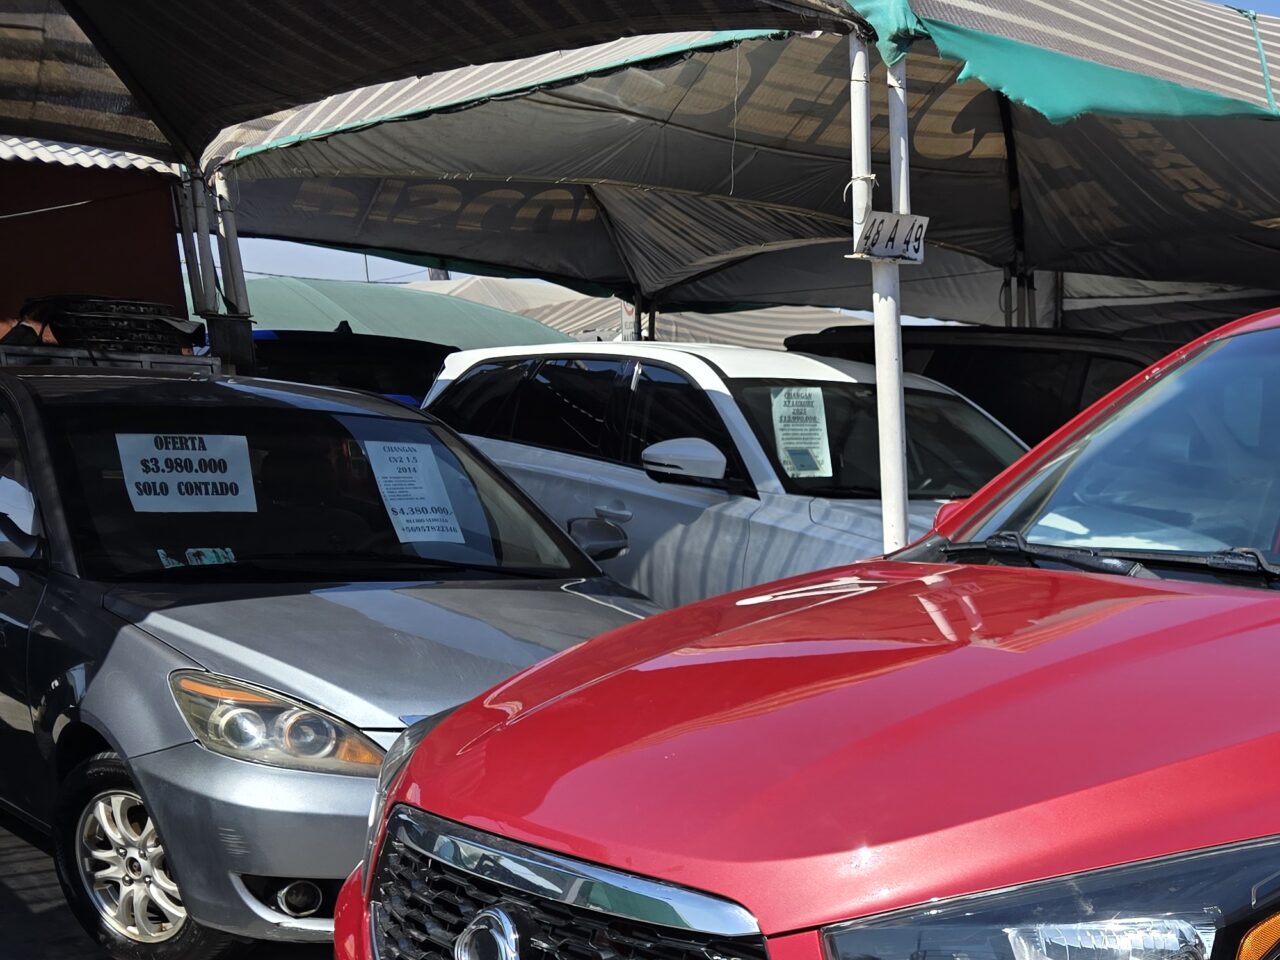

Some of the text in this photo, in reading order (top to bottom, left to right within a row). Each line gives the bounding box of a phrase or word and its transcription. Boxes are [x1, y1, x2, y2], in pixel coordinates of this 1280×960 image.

[885, 219, 899, 249] A
[903, 220, 924, 254] 49
[154, 435, 207, 451] OFERTA
[383, 445, 417, 453] CHANGAN
[140, 457, 228, 474] $3.980.000
[396, 466, 417, 474] 2014
[134, 481, 239, 496] SOLO CONTADO
